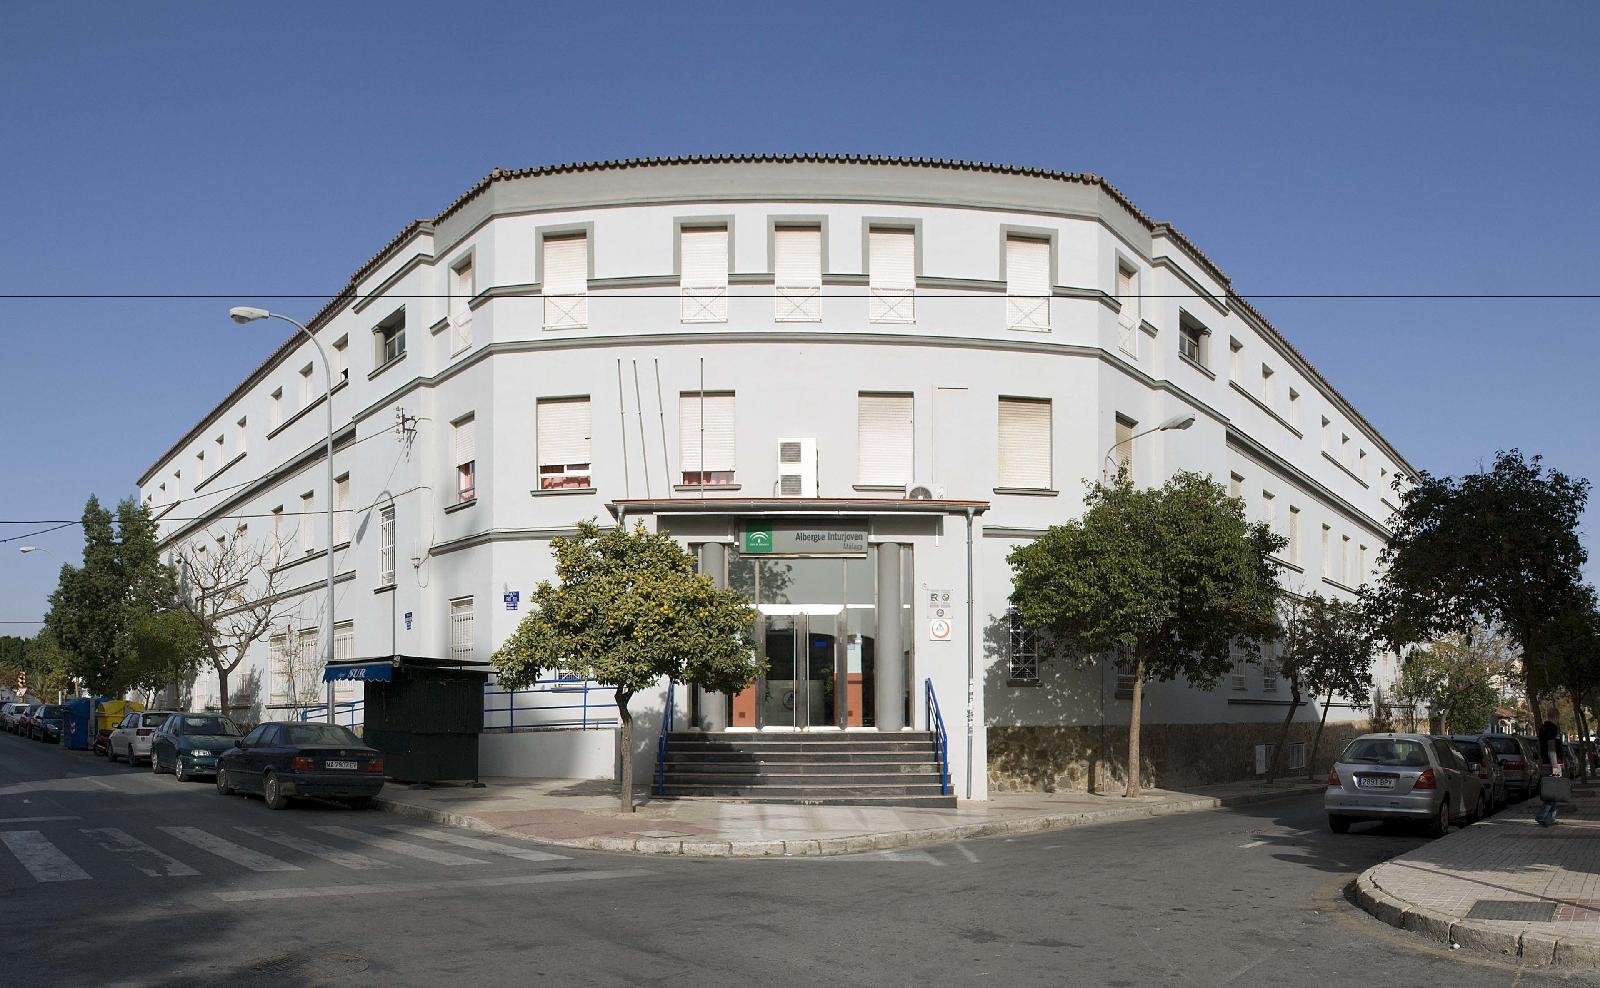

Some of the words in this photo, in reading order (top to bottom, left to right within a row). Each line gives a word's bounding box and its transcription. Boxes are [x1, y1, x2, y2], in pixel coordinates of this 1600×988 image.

[795, 532, 826, 543] Albergue
[827, 532, 863, 542] Inturjoven
[347, 668, 366, 678] SUR
